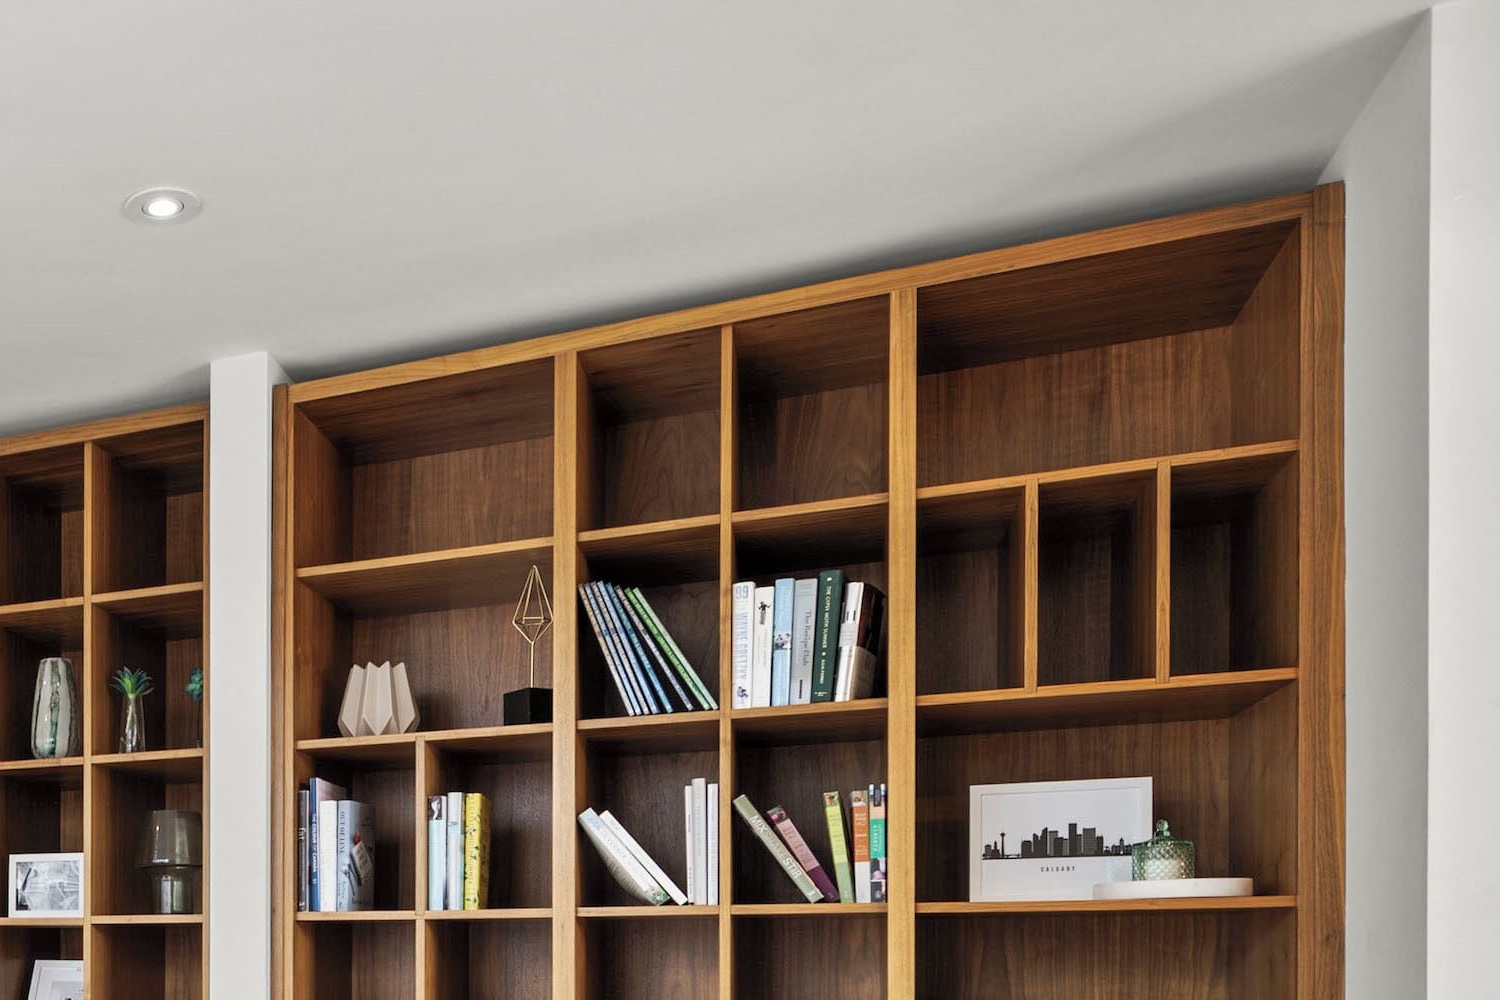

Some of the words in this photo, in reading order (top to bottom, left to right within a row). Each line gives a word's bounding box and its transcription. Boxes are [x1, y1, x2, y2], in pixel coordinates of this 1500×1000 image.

[735, 585, 749, 599] 99
[735, 611, 748, 641] WAYNE
[801, 625, 811, 649] Recipe
[734, 643, 748, 680] GRETZKY
[803, 650, 811, 666] Club
[750, 815, 768, 833] MIX
[782, 857, 802, 878] STIR
